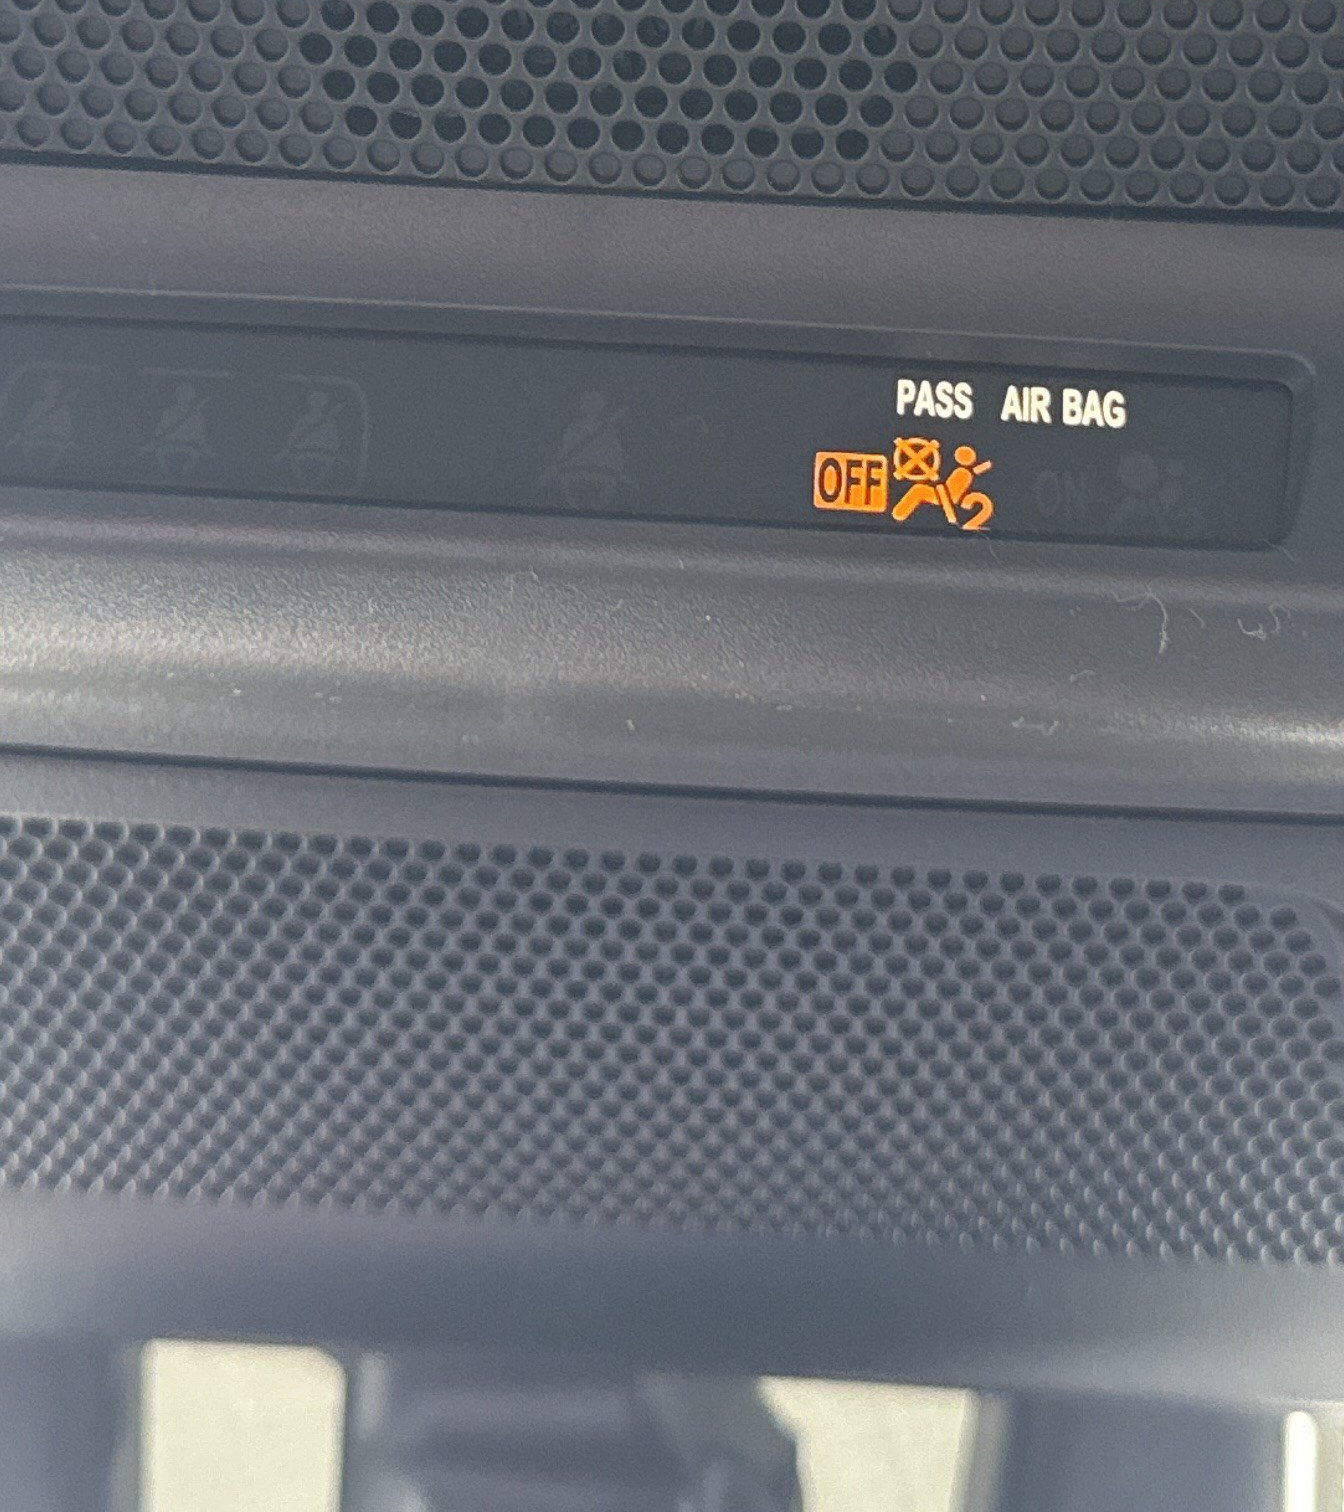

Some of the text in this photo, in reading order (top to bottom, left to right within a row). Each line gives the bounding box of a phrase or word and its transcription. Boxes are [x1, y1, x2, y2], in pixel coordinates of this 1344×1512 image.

[895, 378, 1129, 429] PASS AIR BAG
[817, 457, 884, 508] OFF
